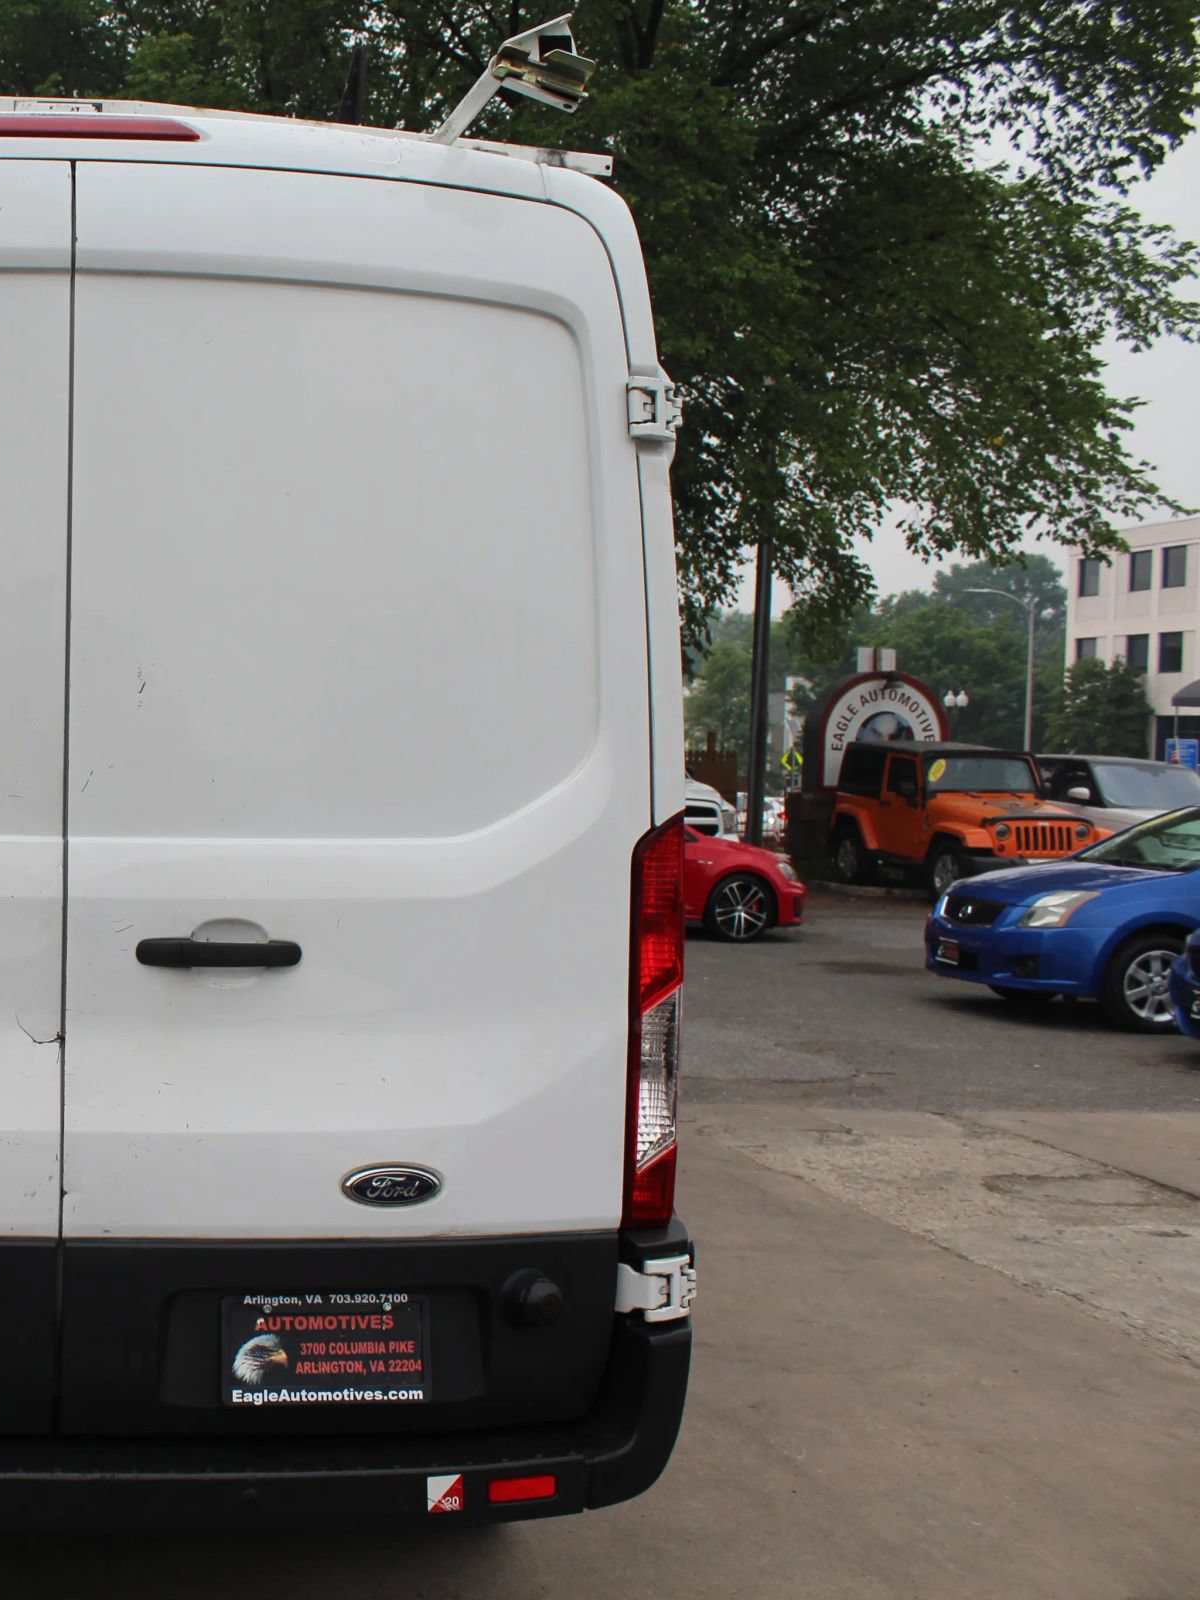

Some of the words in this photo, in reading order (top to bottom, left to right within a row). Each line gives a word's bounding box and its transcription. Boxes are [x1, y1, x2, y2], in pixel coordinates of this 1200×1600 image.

[832, 704, 858, 751] EAGLE
[366, 1176, 419, 1198] Ford
[243, 1294, 302, 1307] Arlington,
[305, 1294, 323, 1304] VA
[329, 1293, 408, 1304] 703.920.7100
[254, 1315, 395, 1331] AUTOMOTIVES
[300, 1342, 326, 1355] 3700
[328, 1341, 386, 1355] COLUMBIA
[388, 1340, 415, 1353] PIKE
[295, 1361, 367, 1376] ARLINGTON,
[369, 1360, 386, 1373] VA
[388, 1359, 423, 1372] 22204
[231, 1387, 424, 1405] EagleAutomotives.com
